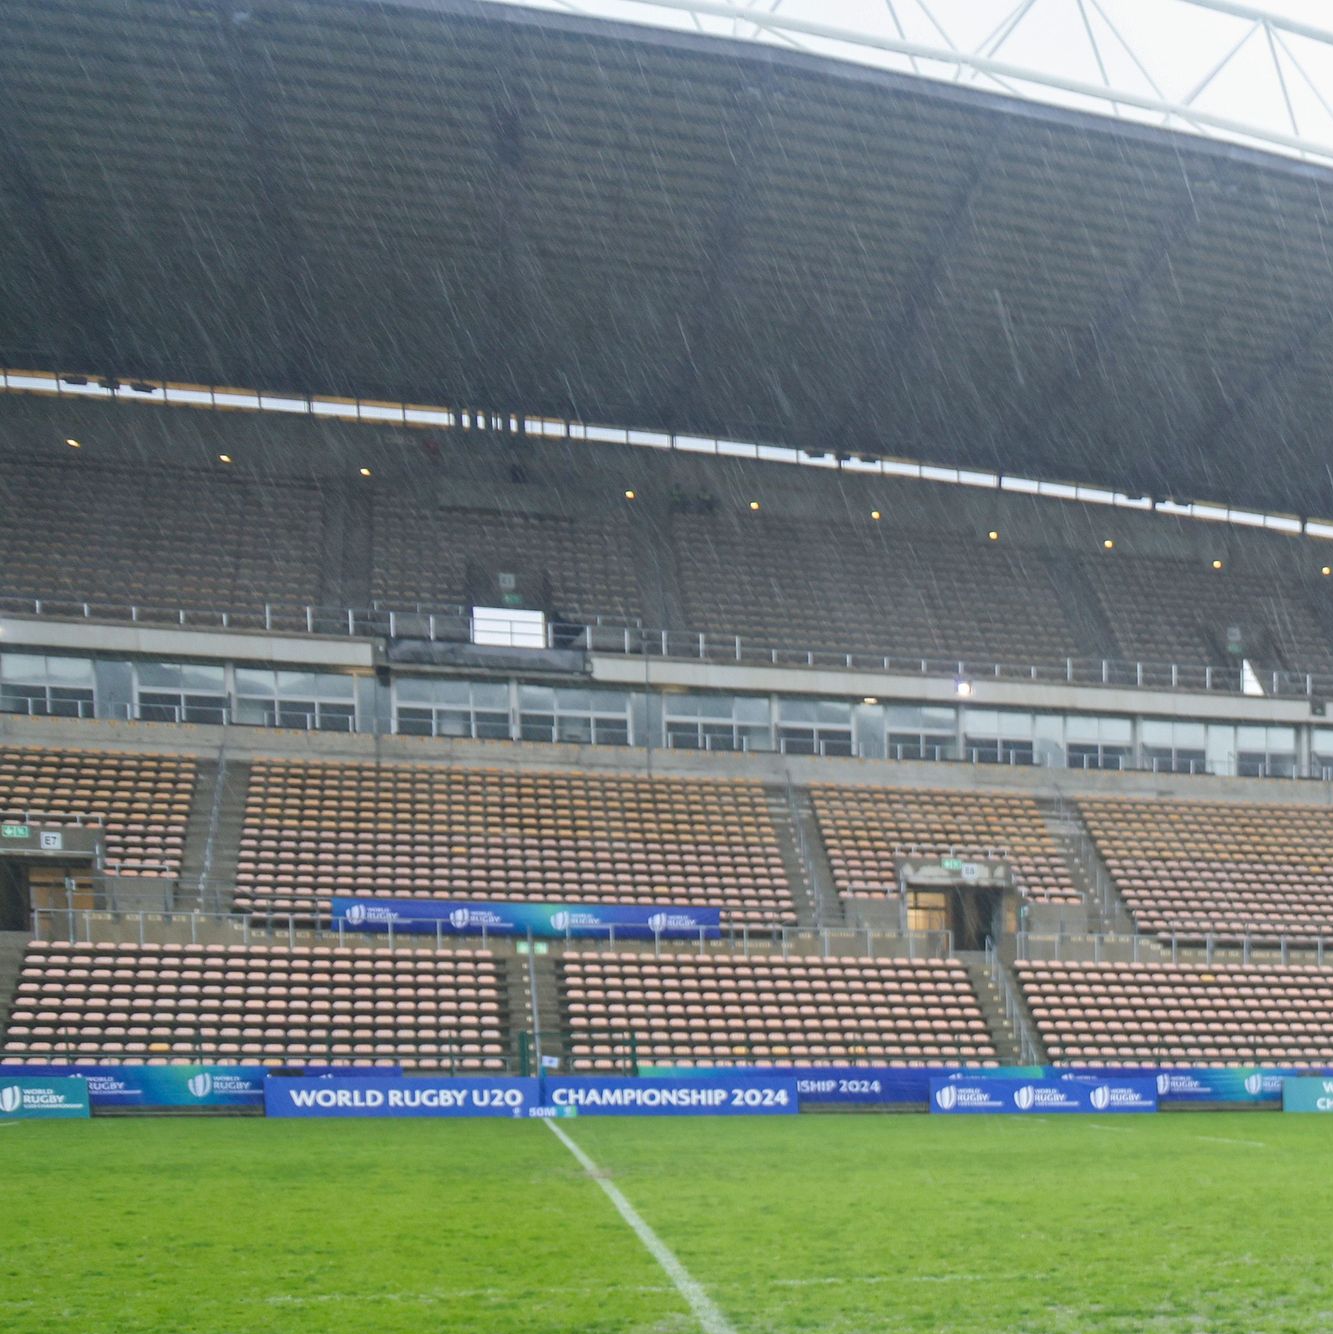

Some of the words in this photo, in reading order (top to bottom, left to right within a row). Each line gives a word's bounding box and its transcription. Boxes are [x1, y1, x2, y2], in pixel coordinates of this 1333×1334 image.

[45, 836, 56, 846] E7
[213, 1081, 251, 1090] RUGBY
[838, 1080, 882, 1093] 2024
[23, 1095, 65, 1103] RUGBY
[289, 1089, 384, 1107] WORLD
[388, 1089, 468, 1107] RUGBY
[472, 1089, 524, 1107] U20
[552, 1088, 729, 1106] CHAMPIONSHIP
[731, 1088, 789, 1106] 2024
[529, 1107, 556, 1117] 50M
